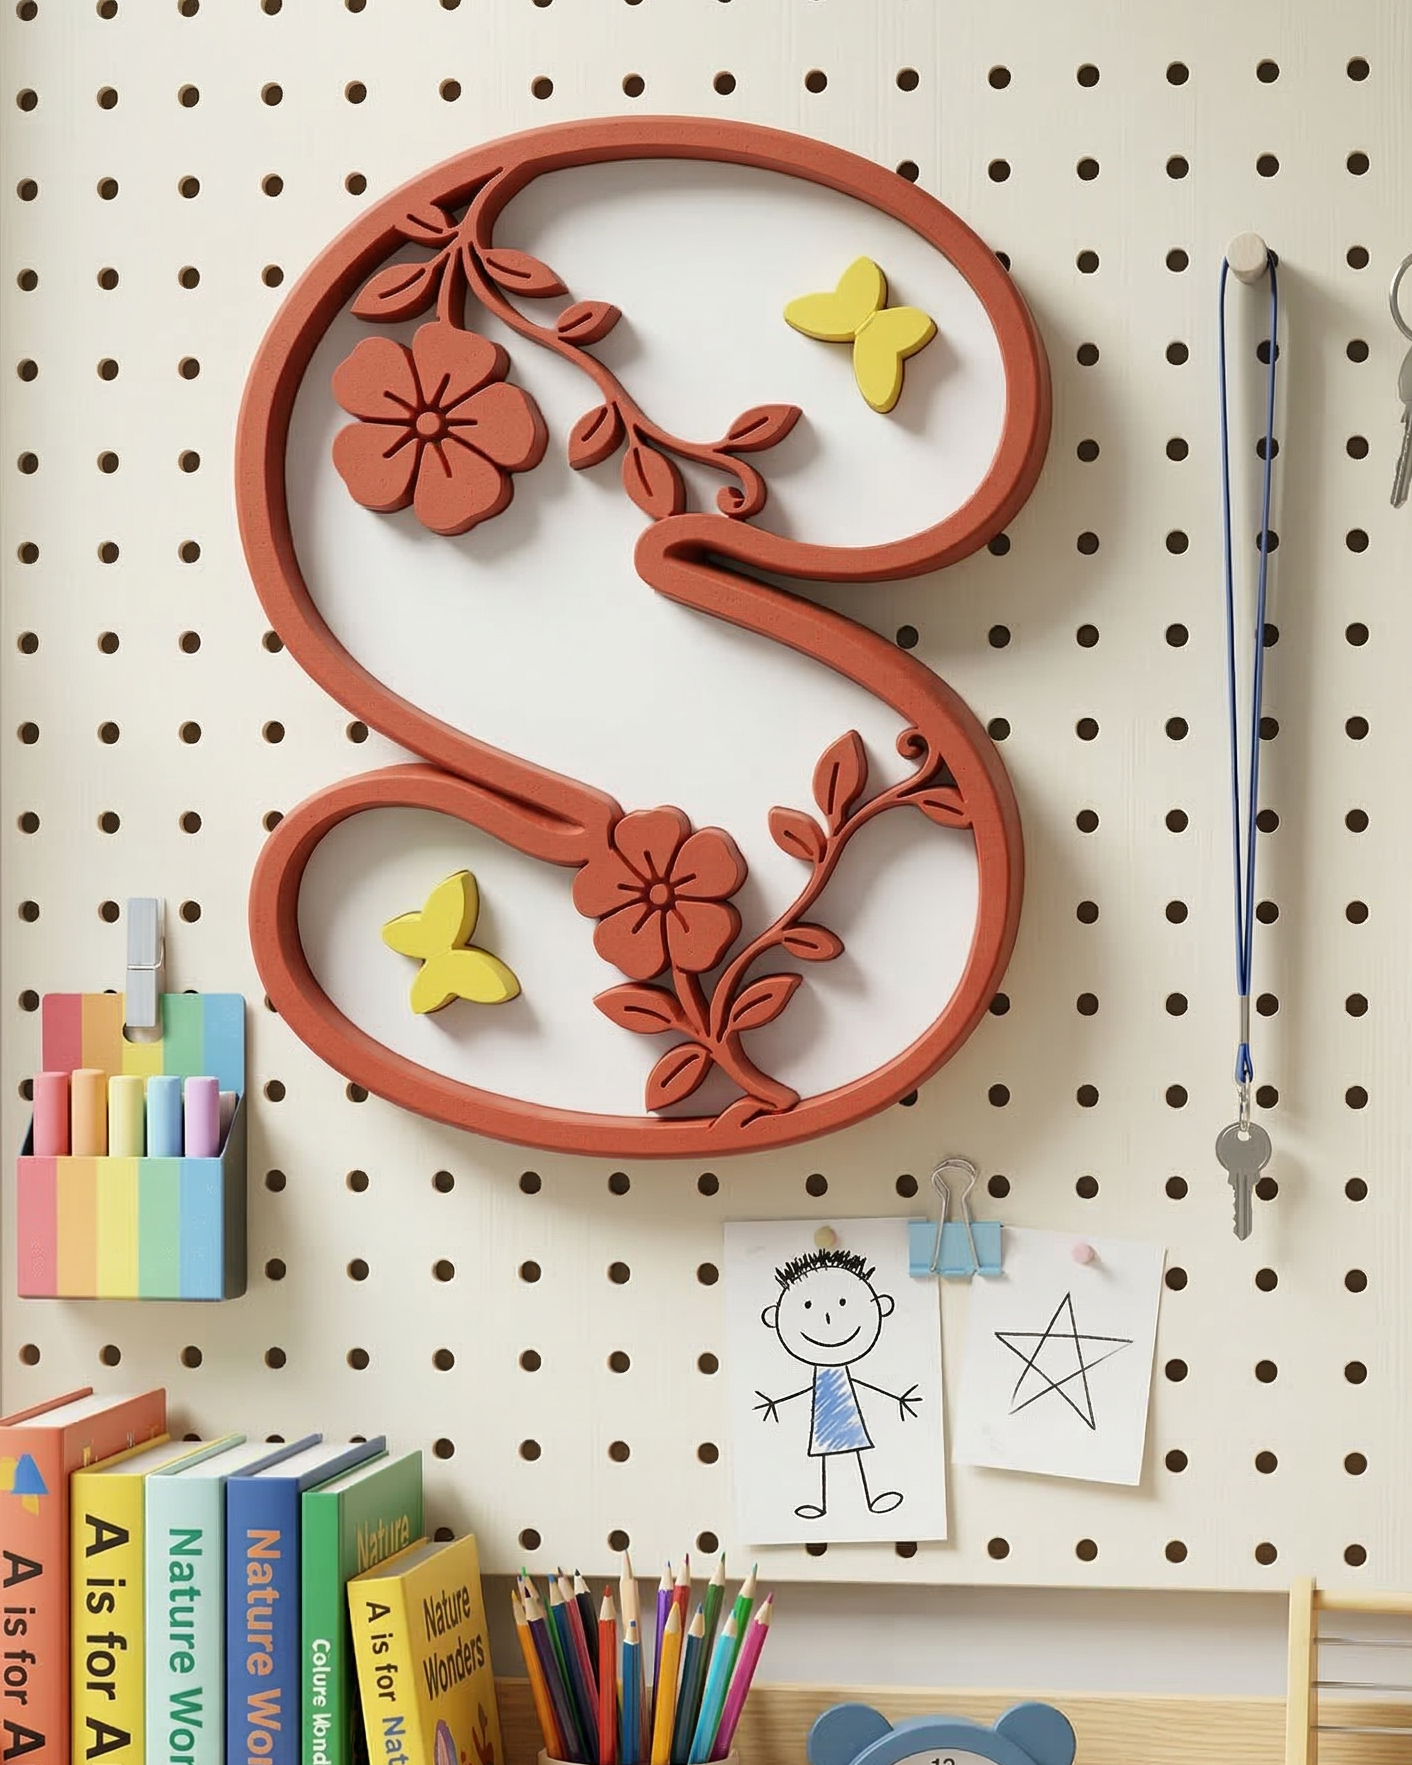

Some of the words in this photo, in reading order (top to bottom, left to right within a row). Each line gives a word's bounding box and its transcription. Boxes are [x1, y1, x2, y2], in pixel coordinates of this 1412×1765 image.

[236, 115, 1051, 1158] S
[86, 1514, 129, 1558] A
[356, 1514, 409, 1572] Nature
[3, 1550, 43, 1588] A
[86, 1579, 126, 1614] is
[169, 1528, 203, 1674] Nature
[246, 1529, 281, 1676] Nature
[366, 1602, 391, 1623] A
[423, 1585, 471, 1642] Nature
[4, 1607, 36, 1636] is
[371, 1633, 394, 1654] is
[4, 1650, 36, 1705] for
[86, 1631, 128, 1700] for
[375, 1664, 398, 1702] for
[423, 1634, 485, 1701] Wonders
[4, 1719, 46, 1761] A
[86, 1716, 131, 1760] A
